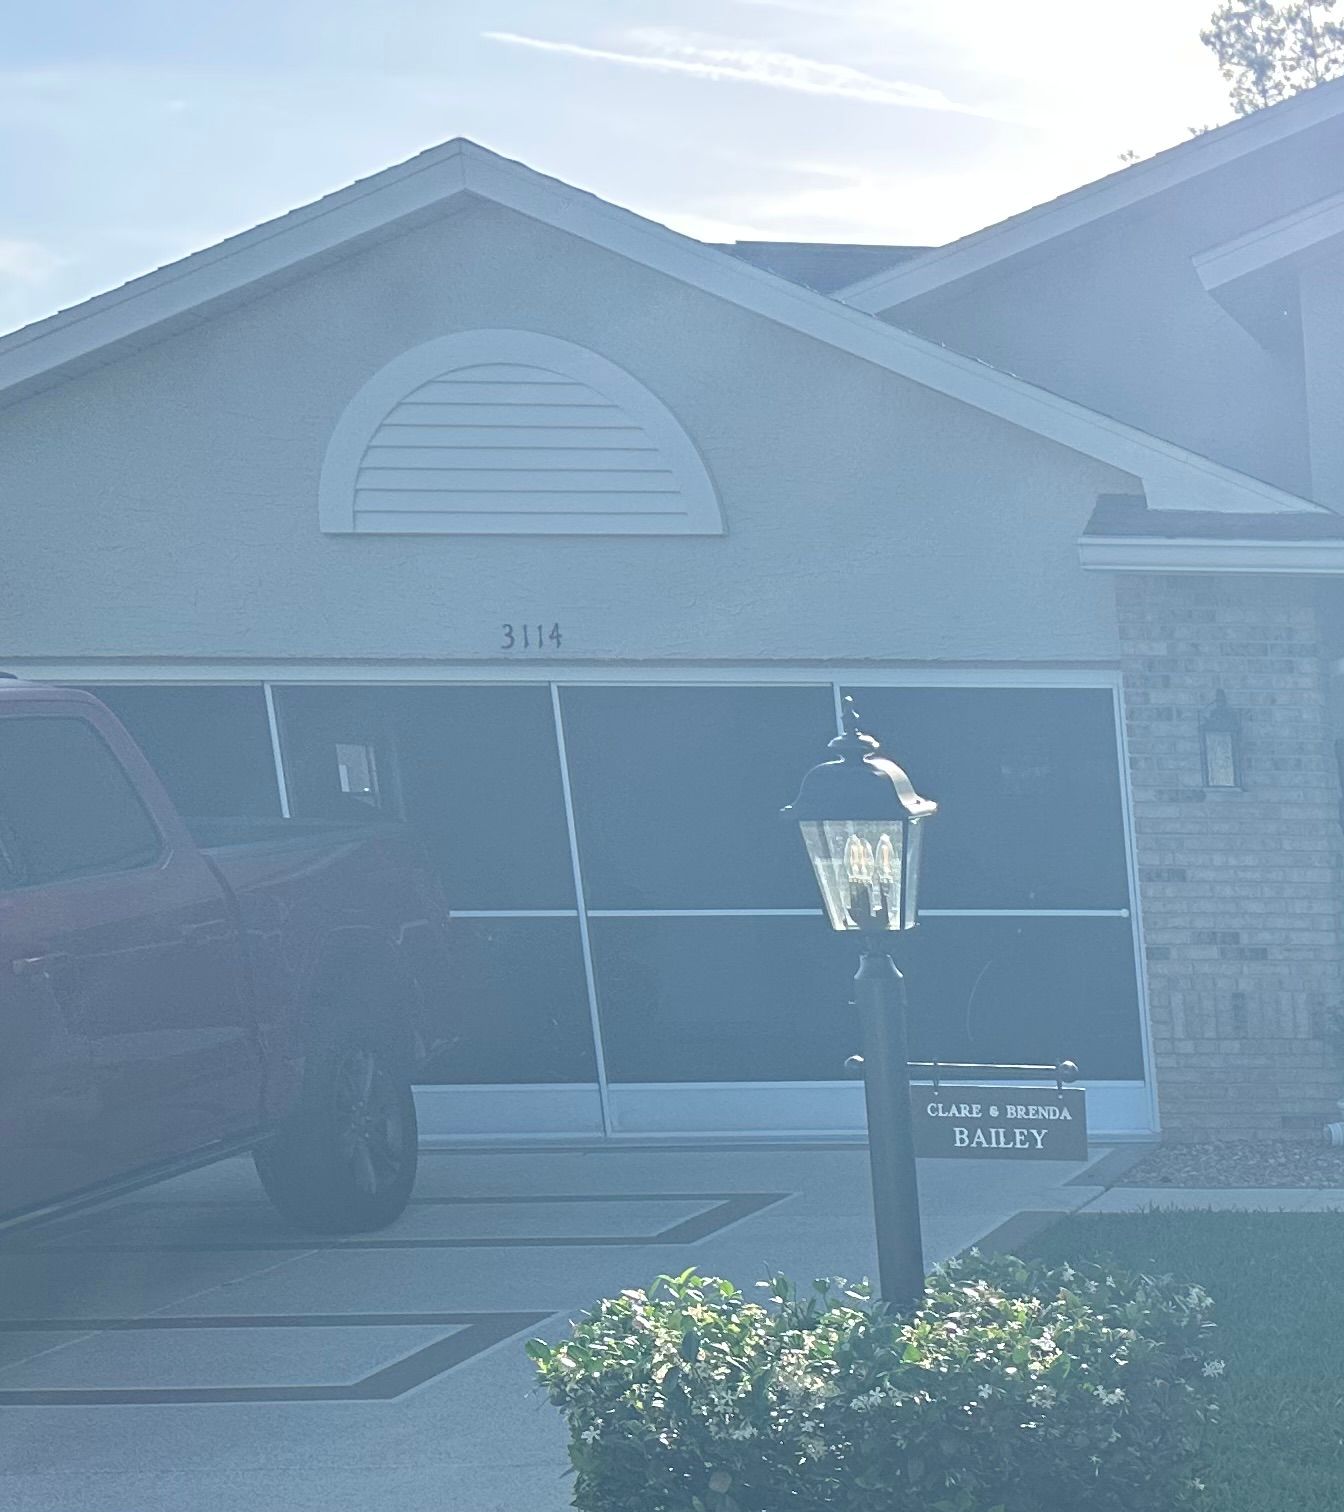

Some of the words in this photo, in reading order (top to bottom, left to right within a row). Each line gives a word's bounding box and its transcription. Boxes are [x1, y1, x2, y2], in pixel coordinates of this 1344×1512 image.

[501, 622, 563, 649] 3114
[927, 1103, 982, 1118] CLARE
[989, 1106, 999, 1117] &
[1006, 1105, 1072, 1120] BRENDA
[953, 1127, 1048, 1149] BAILEY
